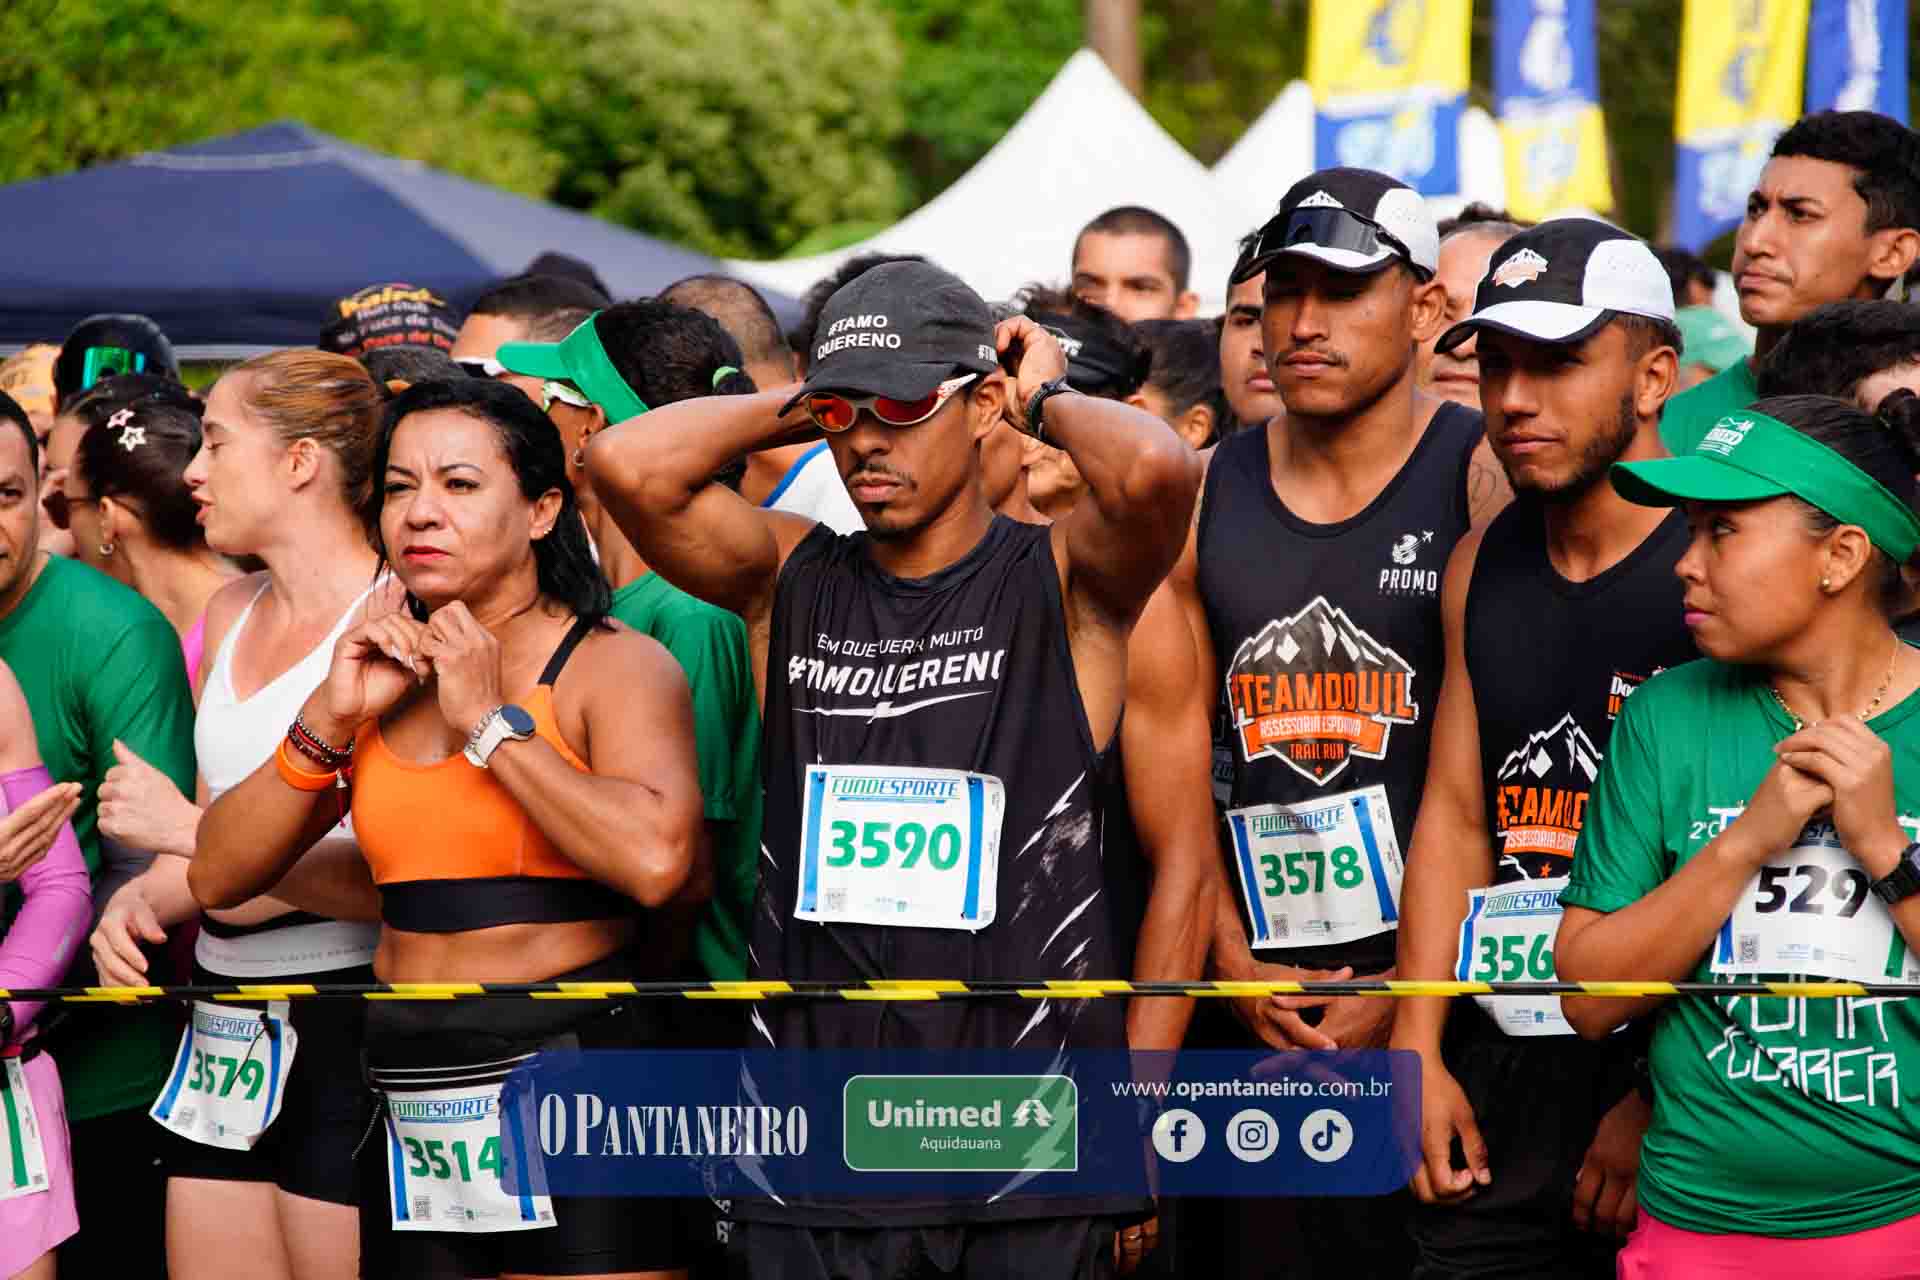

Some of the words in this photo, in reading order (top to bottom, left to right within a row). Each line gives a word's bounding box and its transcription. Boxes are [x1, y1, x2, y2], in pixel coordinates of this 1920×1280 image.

[828, 315, 888, 337] #TAMO
[817, 333, 901, 360] QUERENO
[1379, 569, 1437, 591] PROMO
[816, 632, 839, 655] EM
[930, 626, 984, 649] MUITO
[1322, 743, 1344, 759] RUN
[831, 777, 958, 797] FUNDESPORTE
[826, 821, 961, 870] 3590
[1260, 846, 1364, 896] 3578
[1755, 865, 1871, 919] 529
[1474, 933, 1555, 982] 356
[189, 1050, 265, 1100] 3579
[392, 1098, 494, 1117] FUNDESPORTE
[403, 1135, 505, 1182] 3514
